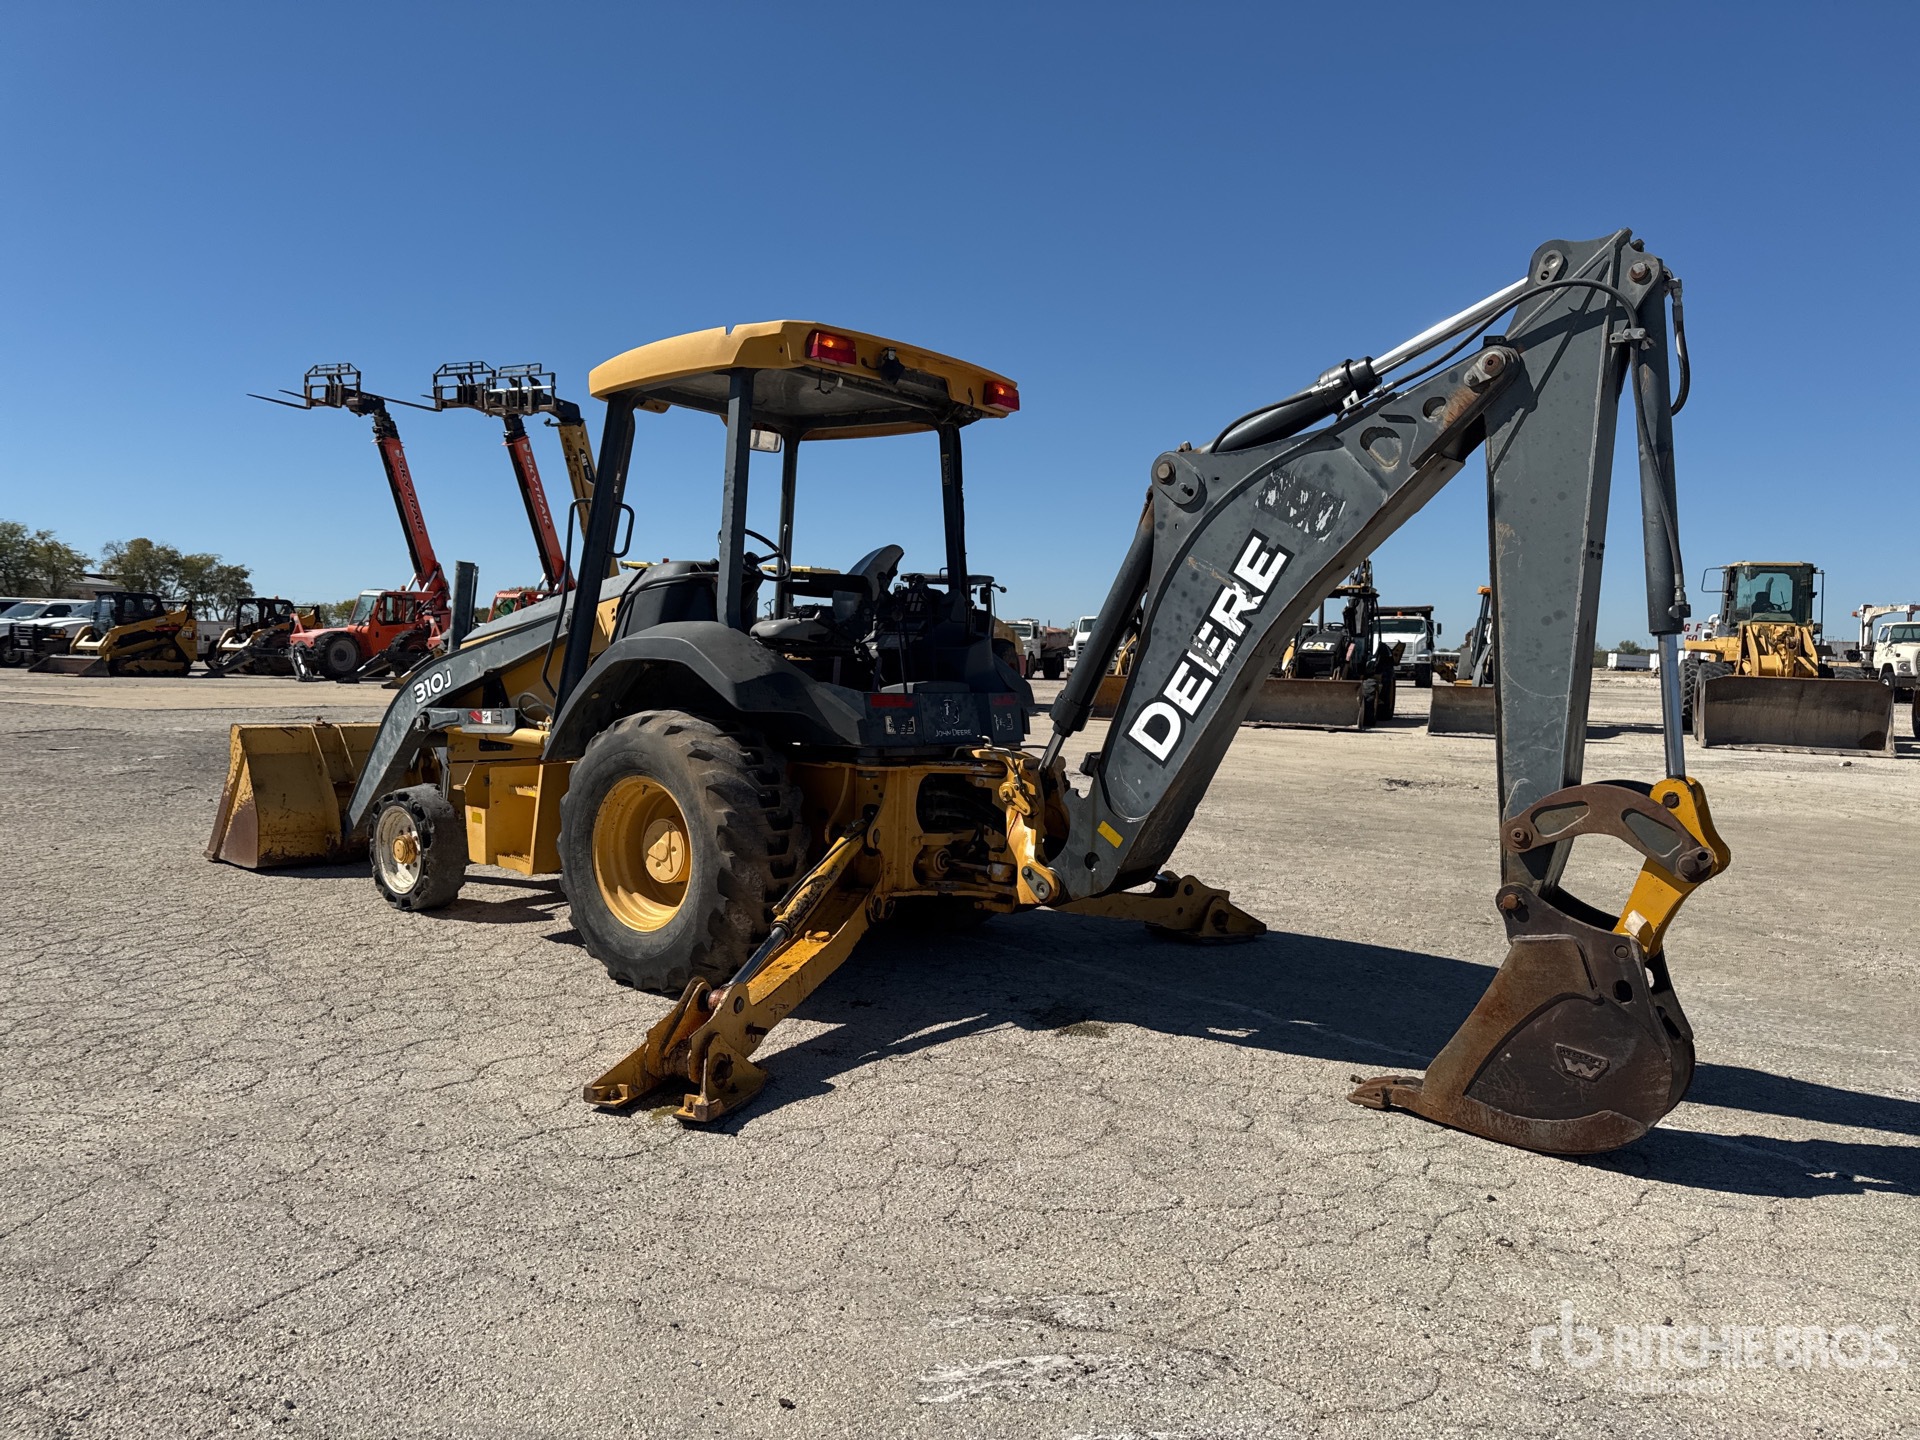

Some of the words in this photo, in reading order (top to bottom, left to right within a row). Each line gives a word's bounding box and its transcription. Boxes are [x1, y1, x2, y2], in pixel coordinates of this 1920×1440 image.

[398, 460, 424, 534] SKYTRAK
[525, 455, 551, 526] SKYTRAK
[1127, 535, 1288, 763] DEERE
[1302, 641, 1335, 651] CAT
[413, 669, 452, 704] 310J
[935, 729, 951, 737] JOHN
[952, 728, 972, 737] DEERE
